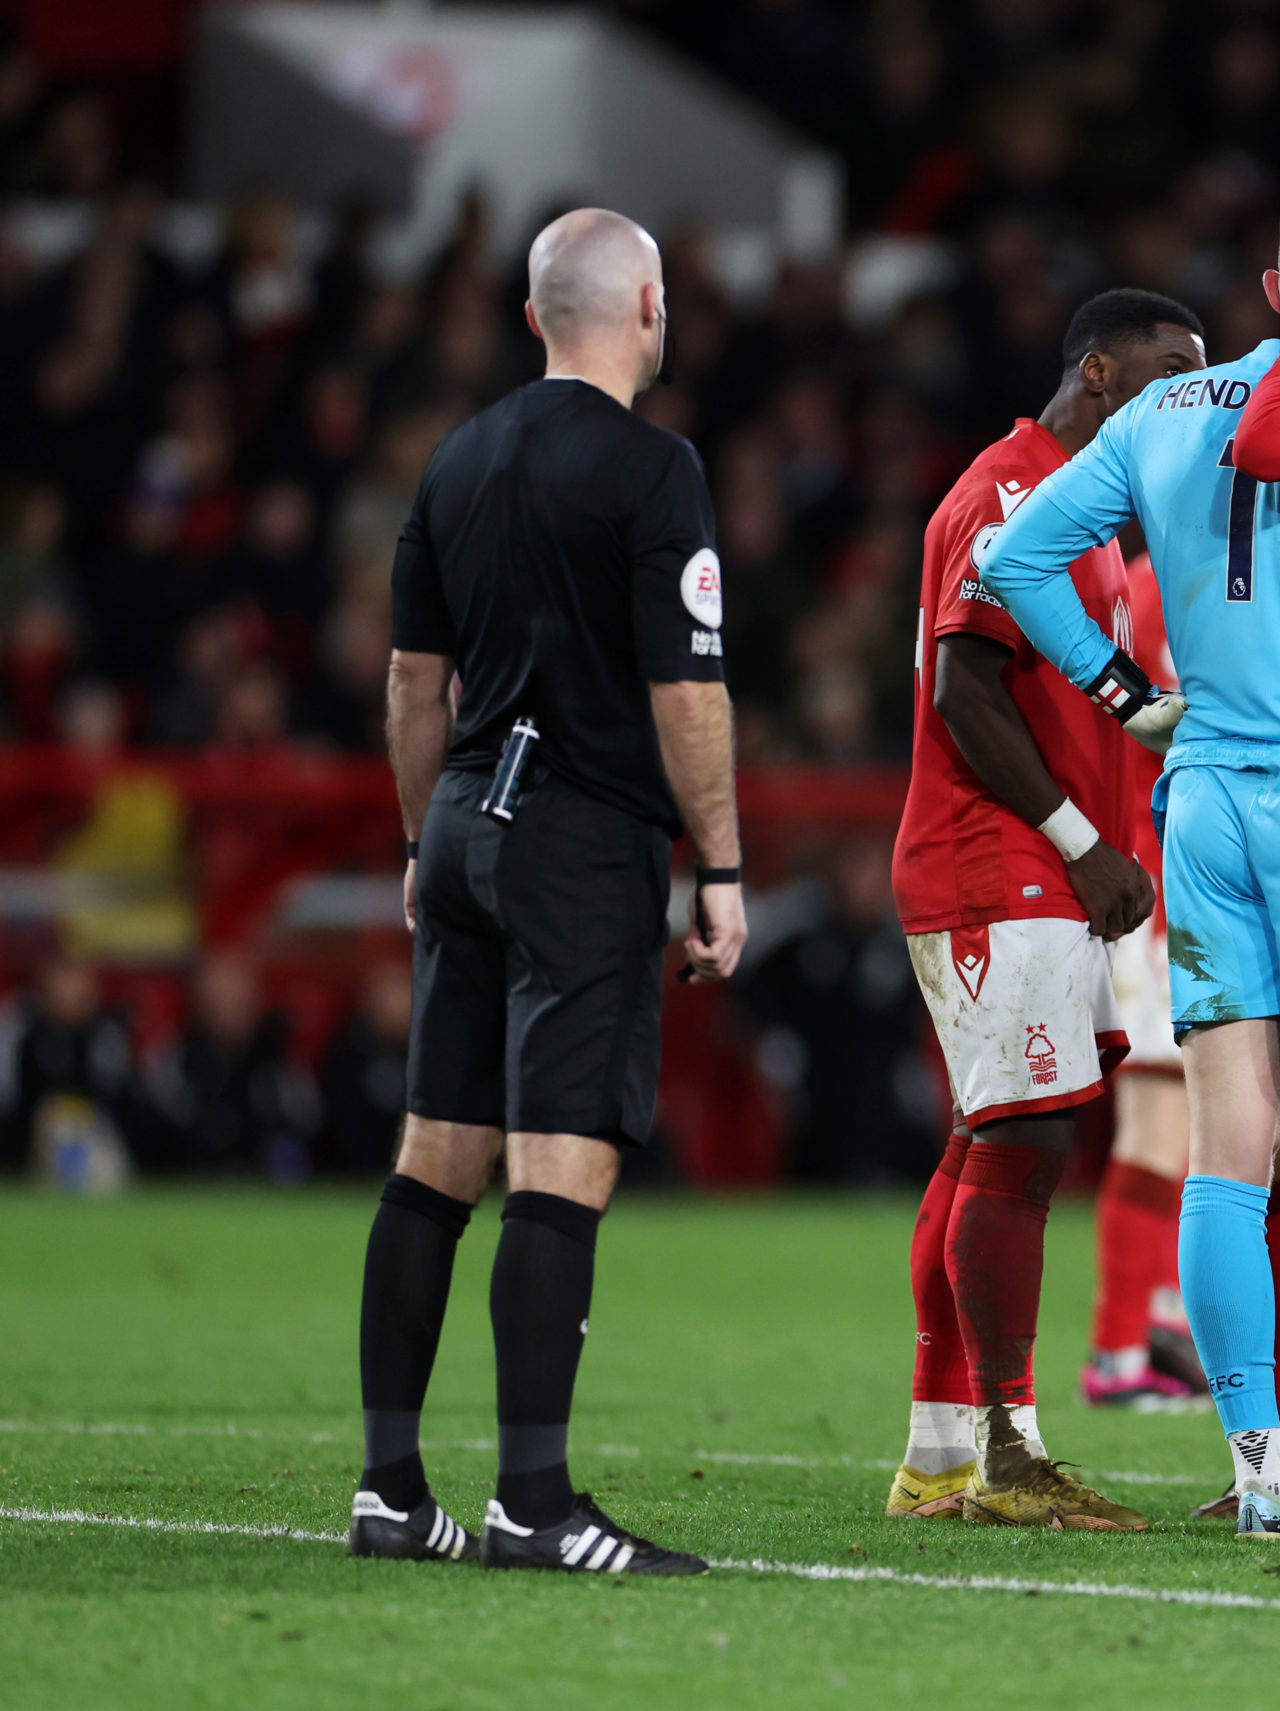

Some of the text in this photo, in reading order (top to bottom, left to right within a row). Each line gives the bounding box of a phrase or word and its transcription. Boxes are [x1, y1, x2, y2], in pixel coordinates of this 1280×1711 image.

[1216, 437, 1260, 603] 1
[961, 579, 978, 591] No
[1208, 1373, 1246, 1394] FFC
